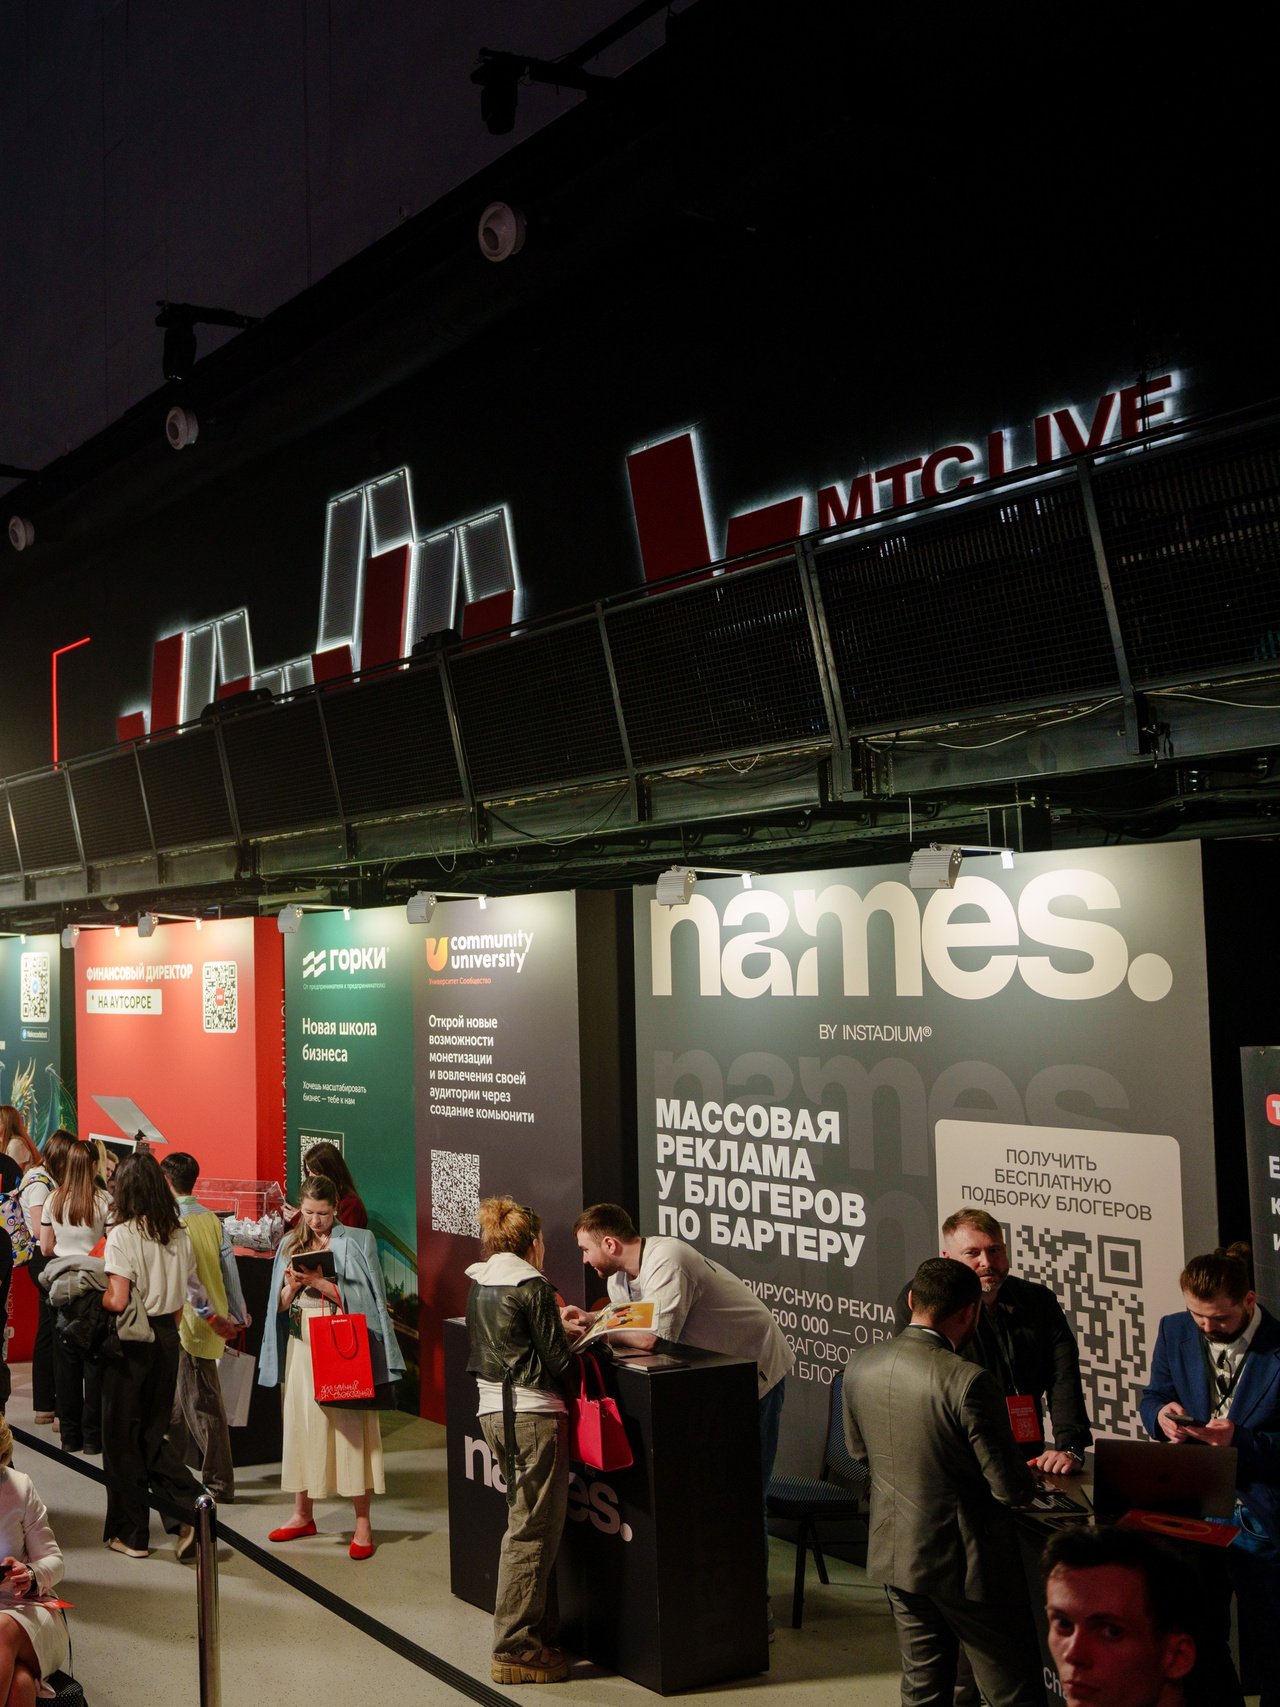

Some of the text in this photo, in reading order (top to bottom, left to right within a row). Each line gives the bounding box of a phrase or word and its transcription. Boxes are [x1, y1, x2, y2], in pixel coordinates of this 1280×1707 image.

[988, 374, 1173, 480] LIVE
[451, 929, 534, 953] community
[651, 869, 1173, 1001] names.
[451, 949, 526, 973] university
[86, 963, 193, 982] ФИНАНСОВЫЙ ДИРЕКТОР
[98, 995, 152, 1009] НА АУТСОРСЕ
[302, 1017, 377, 1036] Новая школа
[429, 1014, 498, 1031] Открой новые
[819, 1024, 838, 1040] BY
[429, 1035, 494, 1046] возможности
[302, 1043, 348, 1062] бизнеса
[429, 1052, 493, 1066] монетизации
[303, 1081, 321, 1090] Хочешь
[429, 1070, 526, 1085] и вовлечения своей
[303, 1093, 321, 1102] бизнес
[327, 1095, 339, 1104] тебе
[430, 1086, 511, 1105] аудитории через
[430, 1104, 534, 1123] создание комьюнити
[656, 1098, 840, 1144] МАССОВАЯ
[656, 1133, 815, 1181] РЕКЛАМА
[1006, 1149, 1097, 1171] ПОЛУЧИТЬ
[995, 1168, 1112, 1194] БЕСПЛАТНУЮ
[656, 1169, 866, 1227] У БЛОГЕРОВ
[962, 1185, 1152, 1221] ПОДБОРКУ БЛОГЕРОВ
[658, 1204, 701, 1241] ПО
[710, 1212, 866, 1268] БАРТЕРУ
[742, 1279, 896, 1325] ВИРУСНУЮ РЕКЛА
[801, 1314, 829, 1336] 000
[854, 1325, 868, 1344] О
